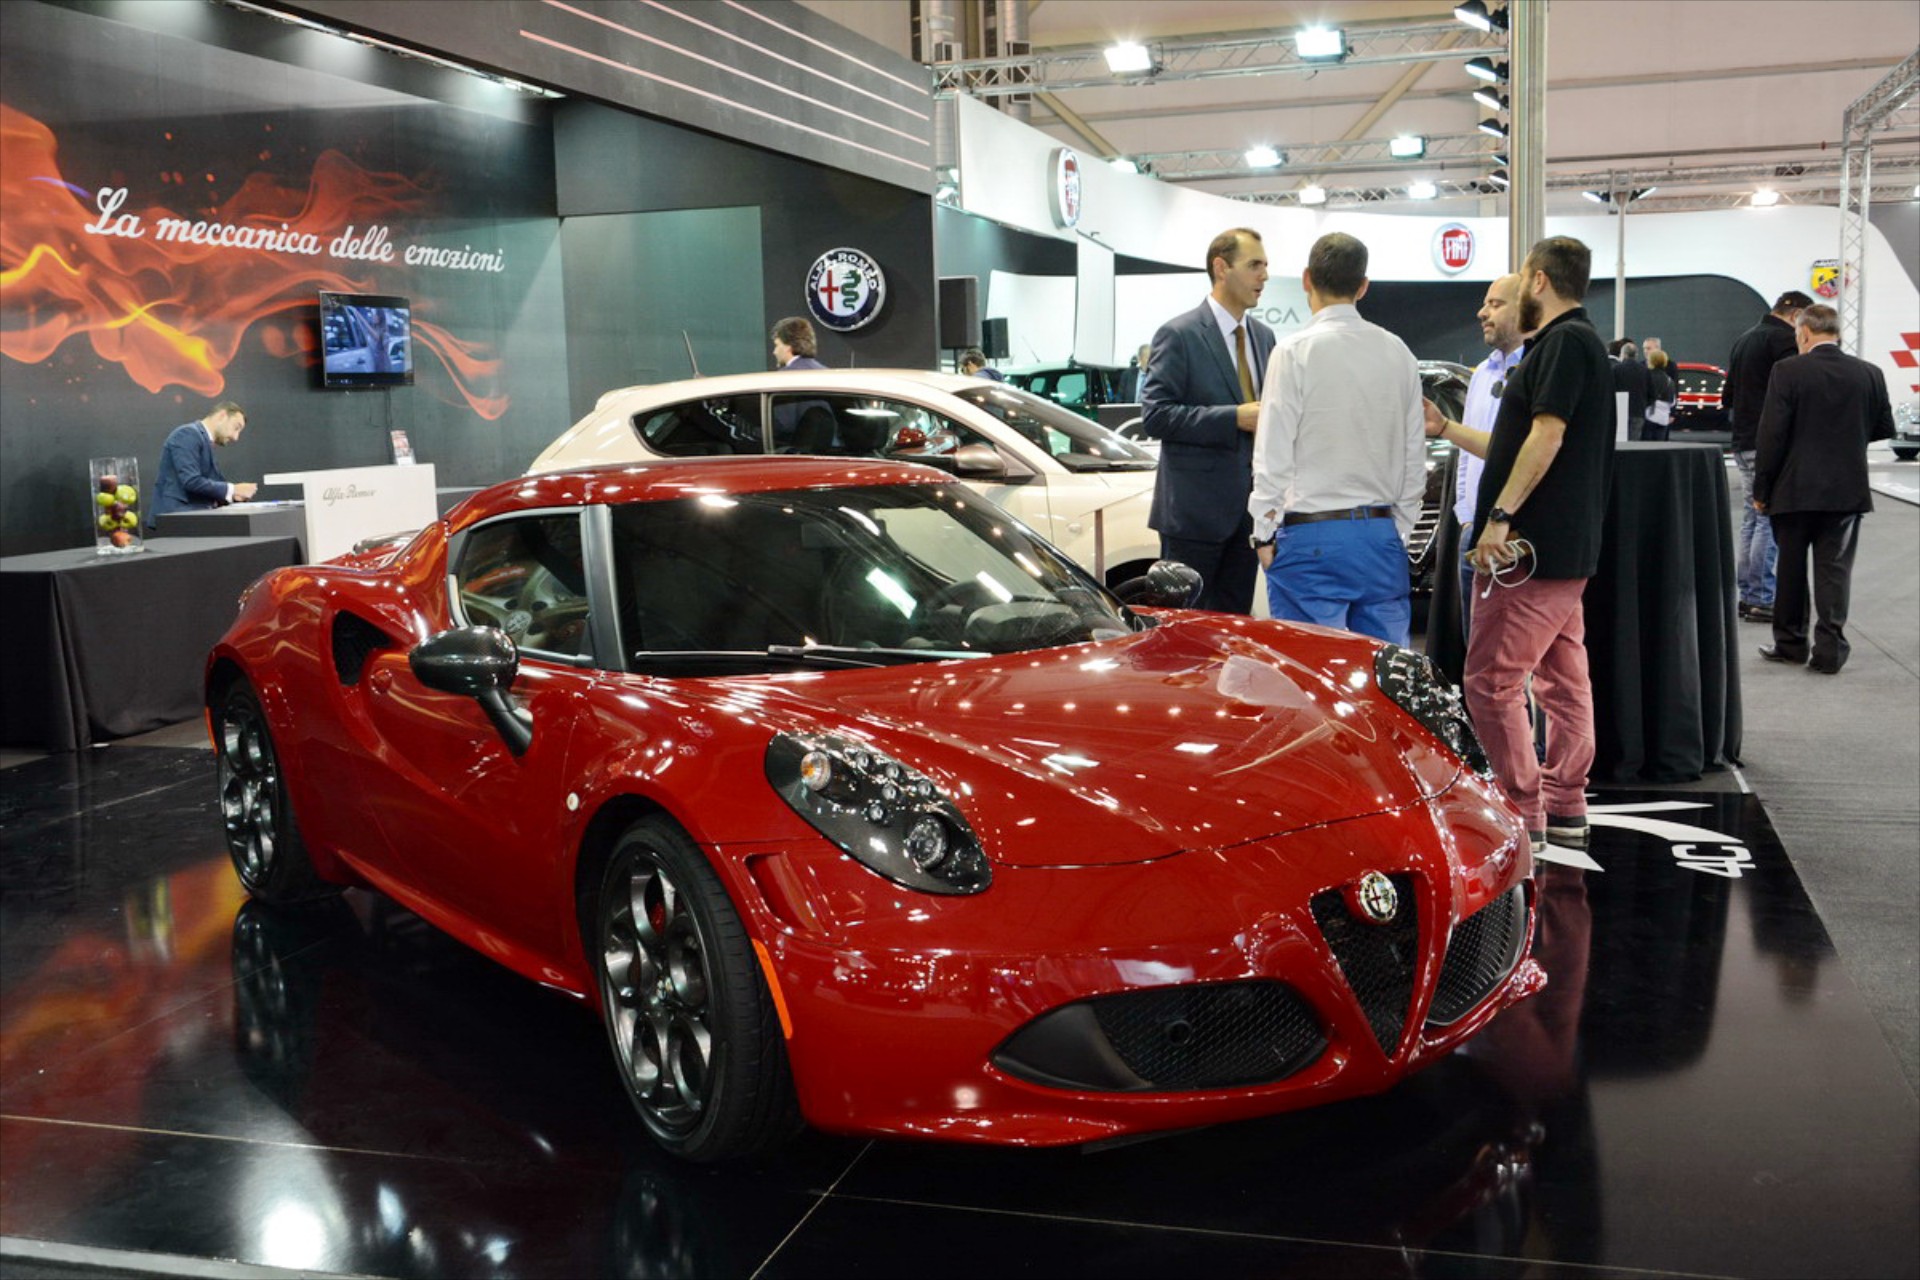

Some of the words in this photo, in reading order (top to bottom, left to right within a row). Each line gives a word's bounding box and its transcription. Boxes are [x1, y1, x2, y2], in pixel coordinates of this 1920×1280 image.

[85, 187, 145, 238] La
[155, 217, 322, 255] meccanica
[329, 225, 395, 262] delle
[405, 244, 504, 272] emozioni
[1445, 235, 1468, 260] FIAT
[810, 257, 838, 291] ALFA
[838, 252, 878, 290] ROMEO
[1671, 844, 1756, 878] 4C
